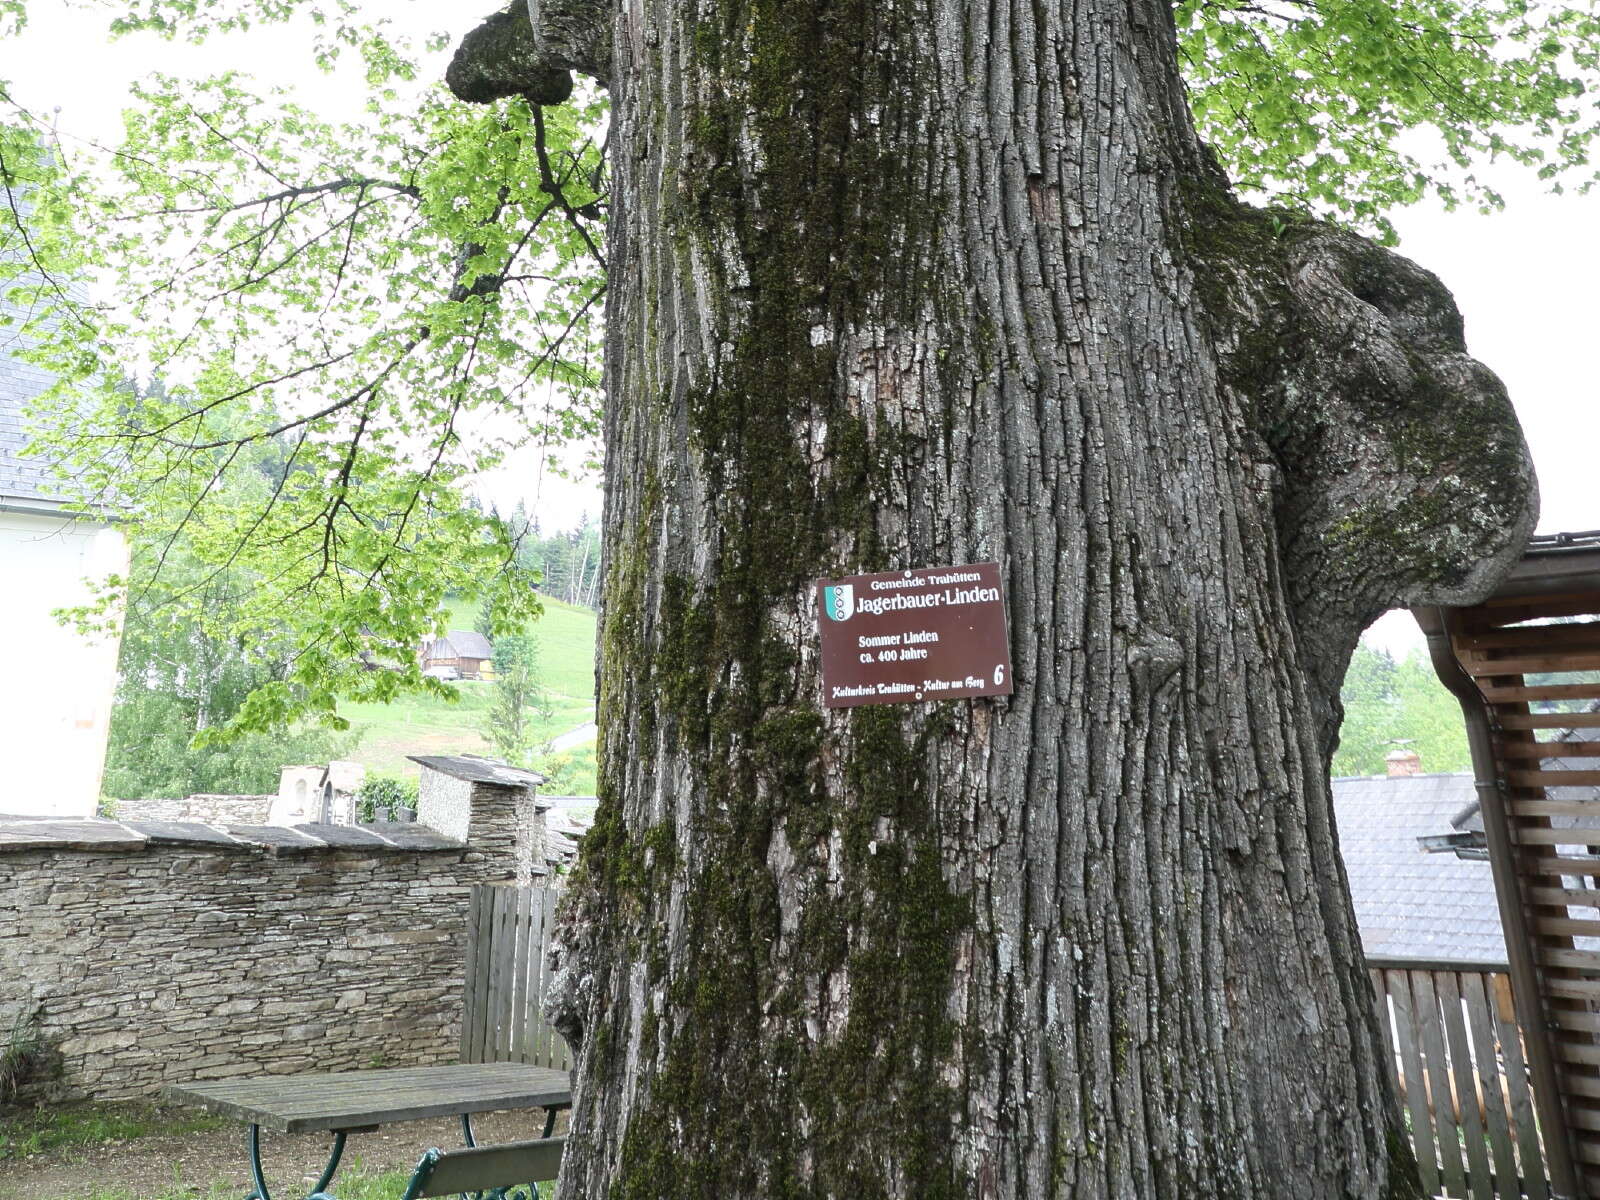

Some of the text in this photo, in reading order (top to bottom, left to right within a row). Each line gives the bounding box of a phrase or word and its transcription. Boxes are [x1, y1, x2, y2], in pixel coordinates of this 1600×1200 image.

[871, 572, 980, 590] Gemeinde Trahütten
[859, 631, 939, 647] Sommer Linden
[860, 648, 927, 664] ca. 400 Jahre
[994, 664, 1004, 685] 6
[832, 685, 875, 698] Kulturkreis
[878, 683, 915, 695] Trahütten
[923, 679, 950, 692] Kultur
